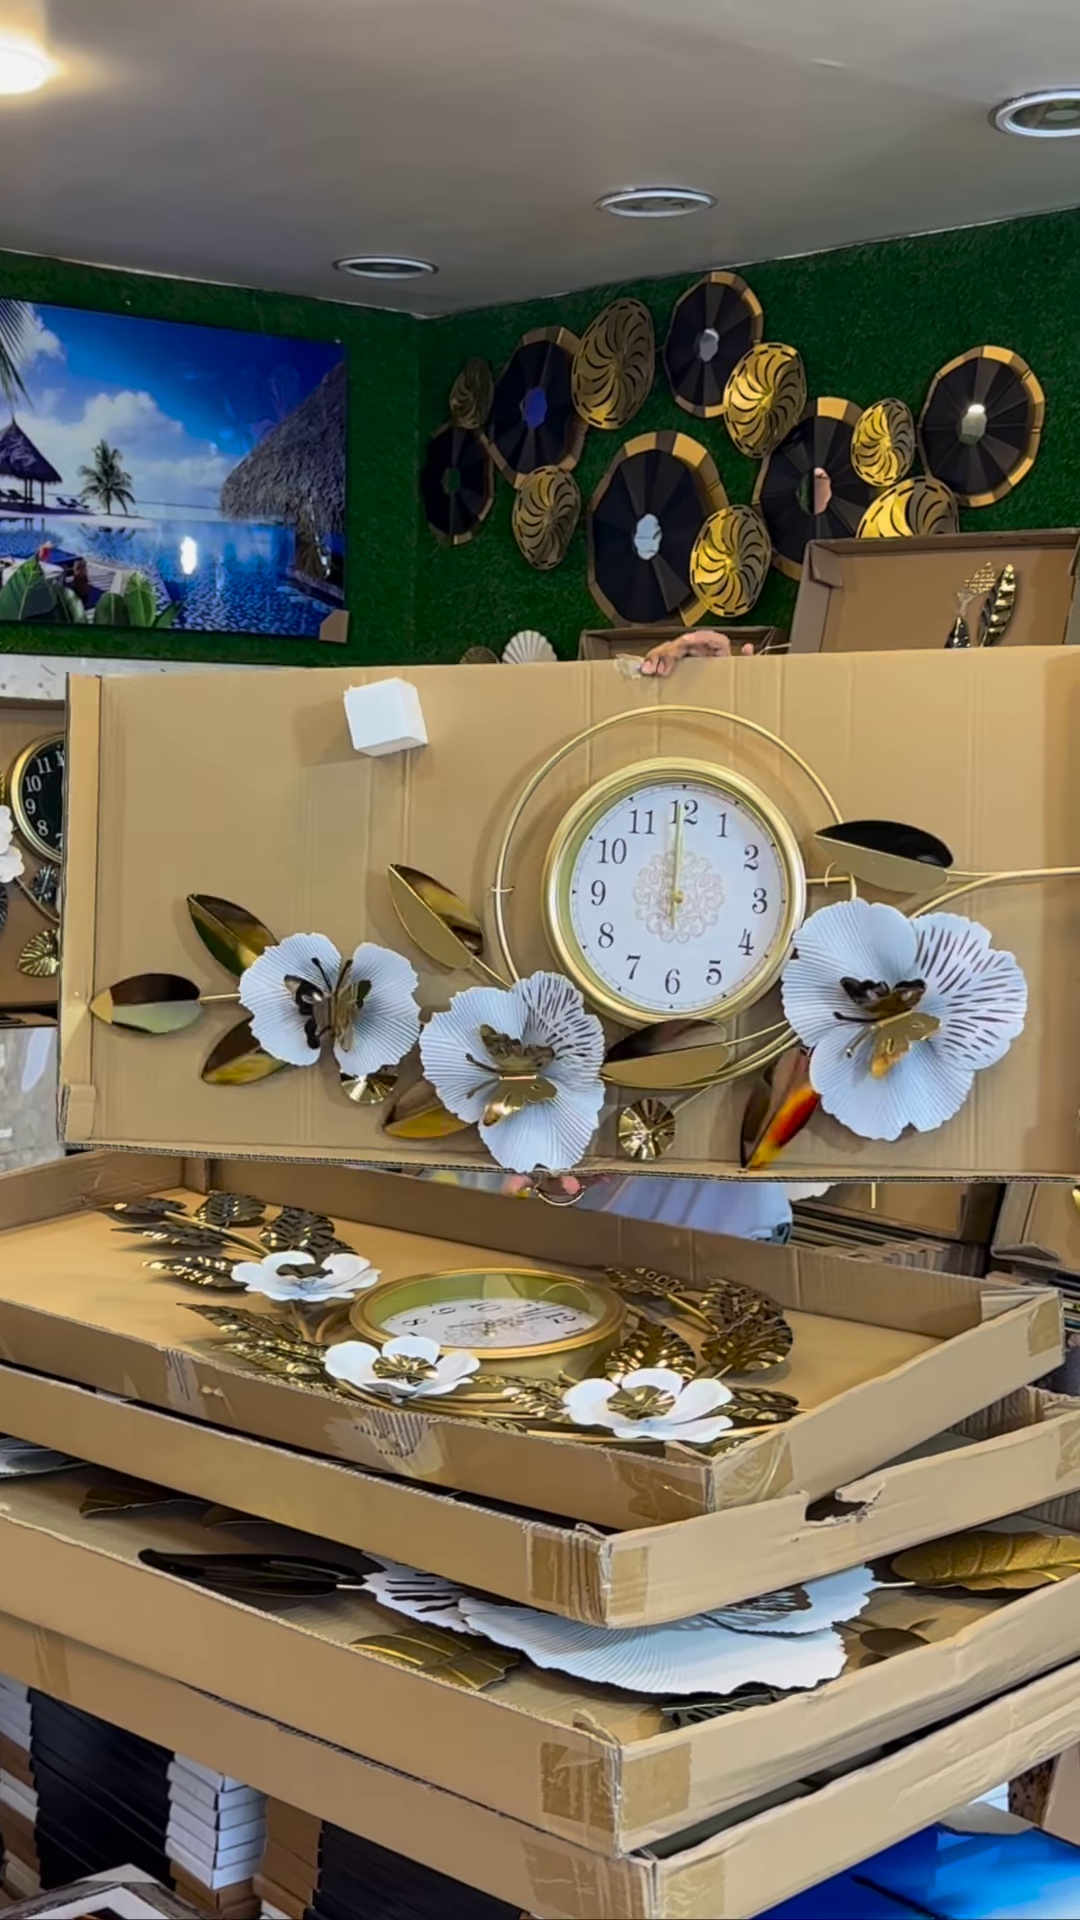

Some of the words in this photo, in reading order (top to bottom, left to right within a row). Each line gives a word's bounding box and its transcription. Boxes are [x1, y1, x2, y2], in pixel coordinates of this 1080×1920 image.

[37, 756, 53, 774] 11
[25, 774, 42, 793] 10
[25, 798, 36, 816] 9
[669, 799, 699, 826] 12
[36, 819, 49, 837] 8
[628, 809, 655, 836] 11
[717, 812, 729, 838] 1
[597, 838, 627, 865] 10
[743, 844, 759, 871] 2
[590, 879, 607, 907] 9
[751, 887, 768, 914] 3
[597, 922, 615, 949] 8
[737, 928, 755, 957] 4
[625, 954, 641, 980] 7
[705, 959, 723, 985] 5
[664, 968, 681, 995] 6
[544, 1312, 577, 1325] 12
